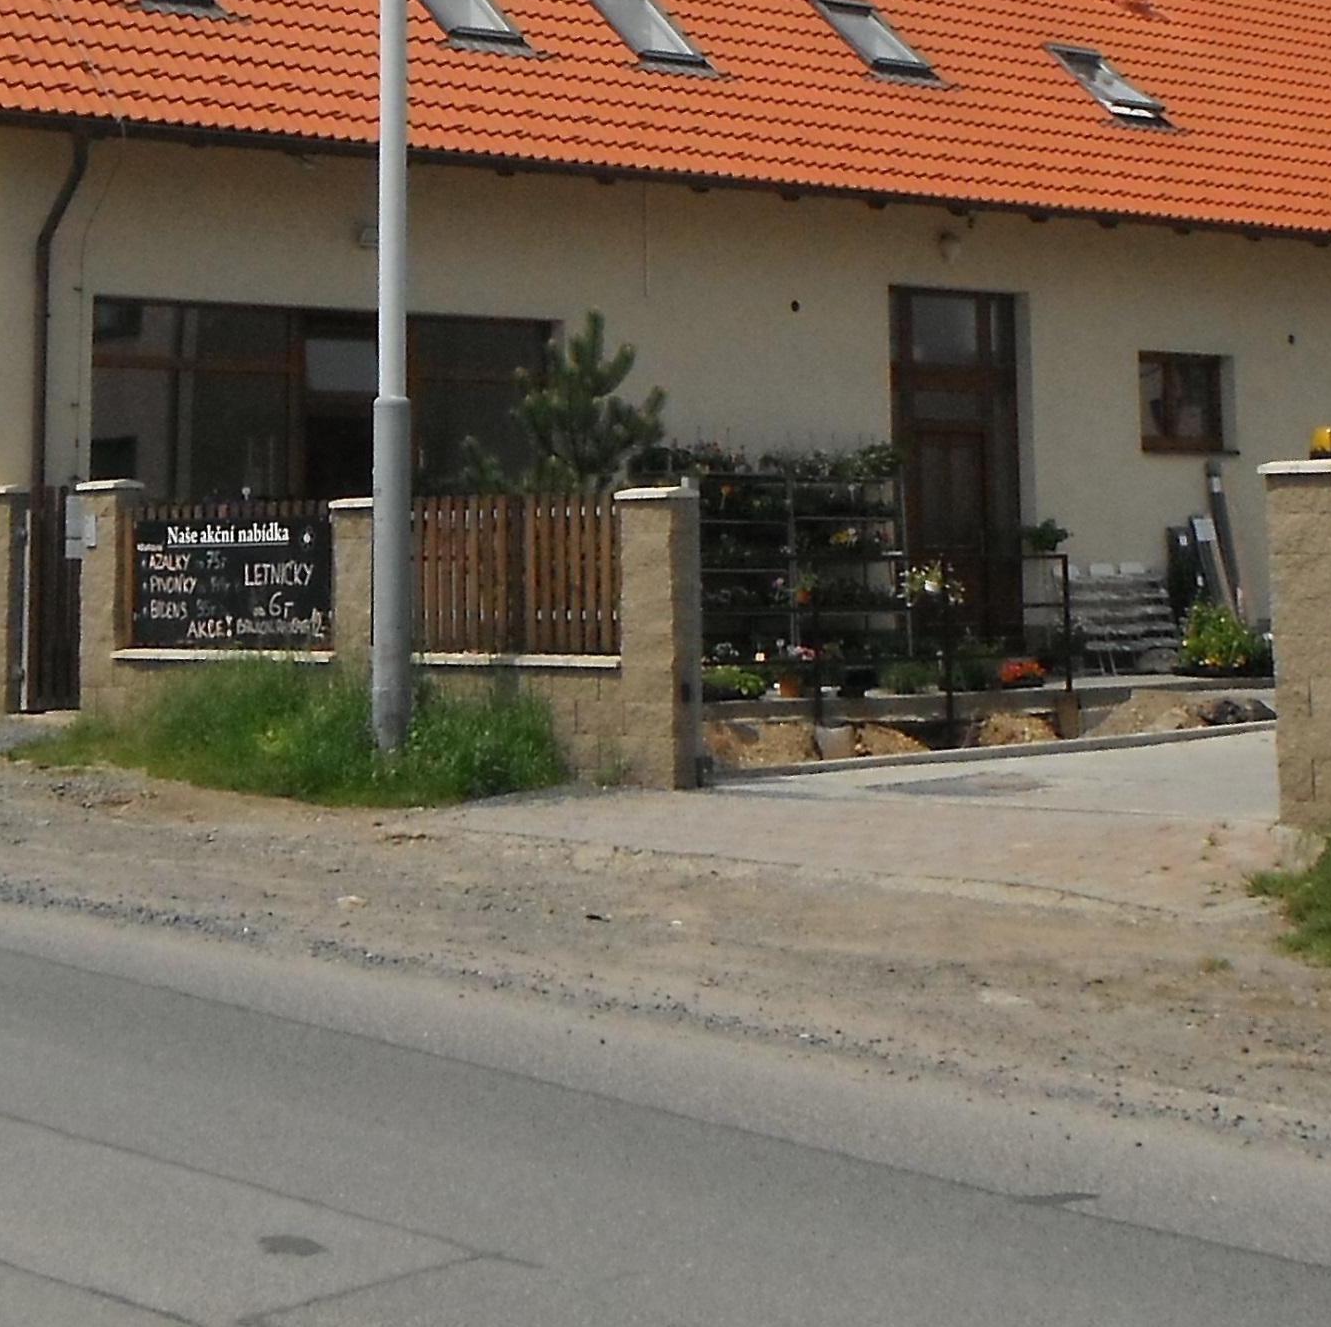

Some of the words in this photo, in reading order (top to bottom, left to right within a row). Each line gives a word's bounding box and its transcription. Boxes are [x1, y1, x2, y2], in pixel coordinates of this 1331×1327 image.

[167, 526, 198, 545] Naše
[200, 524, 235, 544] akční
[237, 522, 290, 543] nabídka
[148, 553, 191, 571] AZALKY
